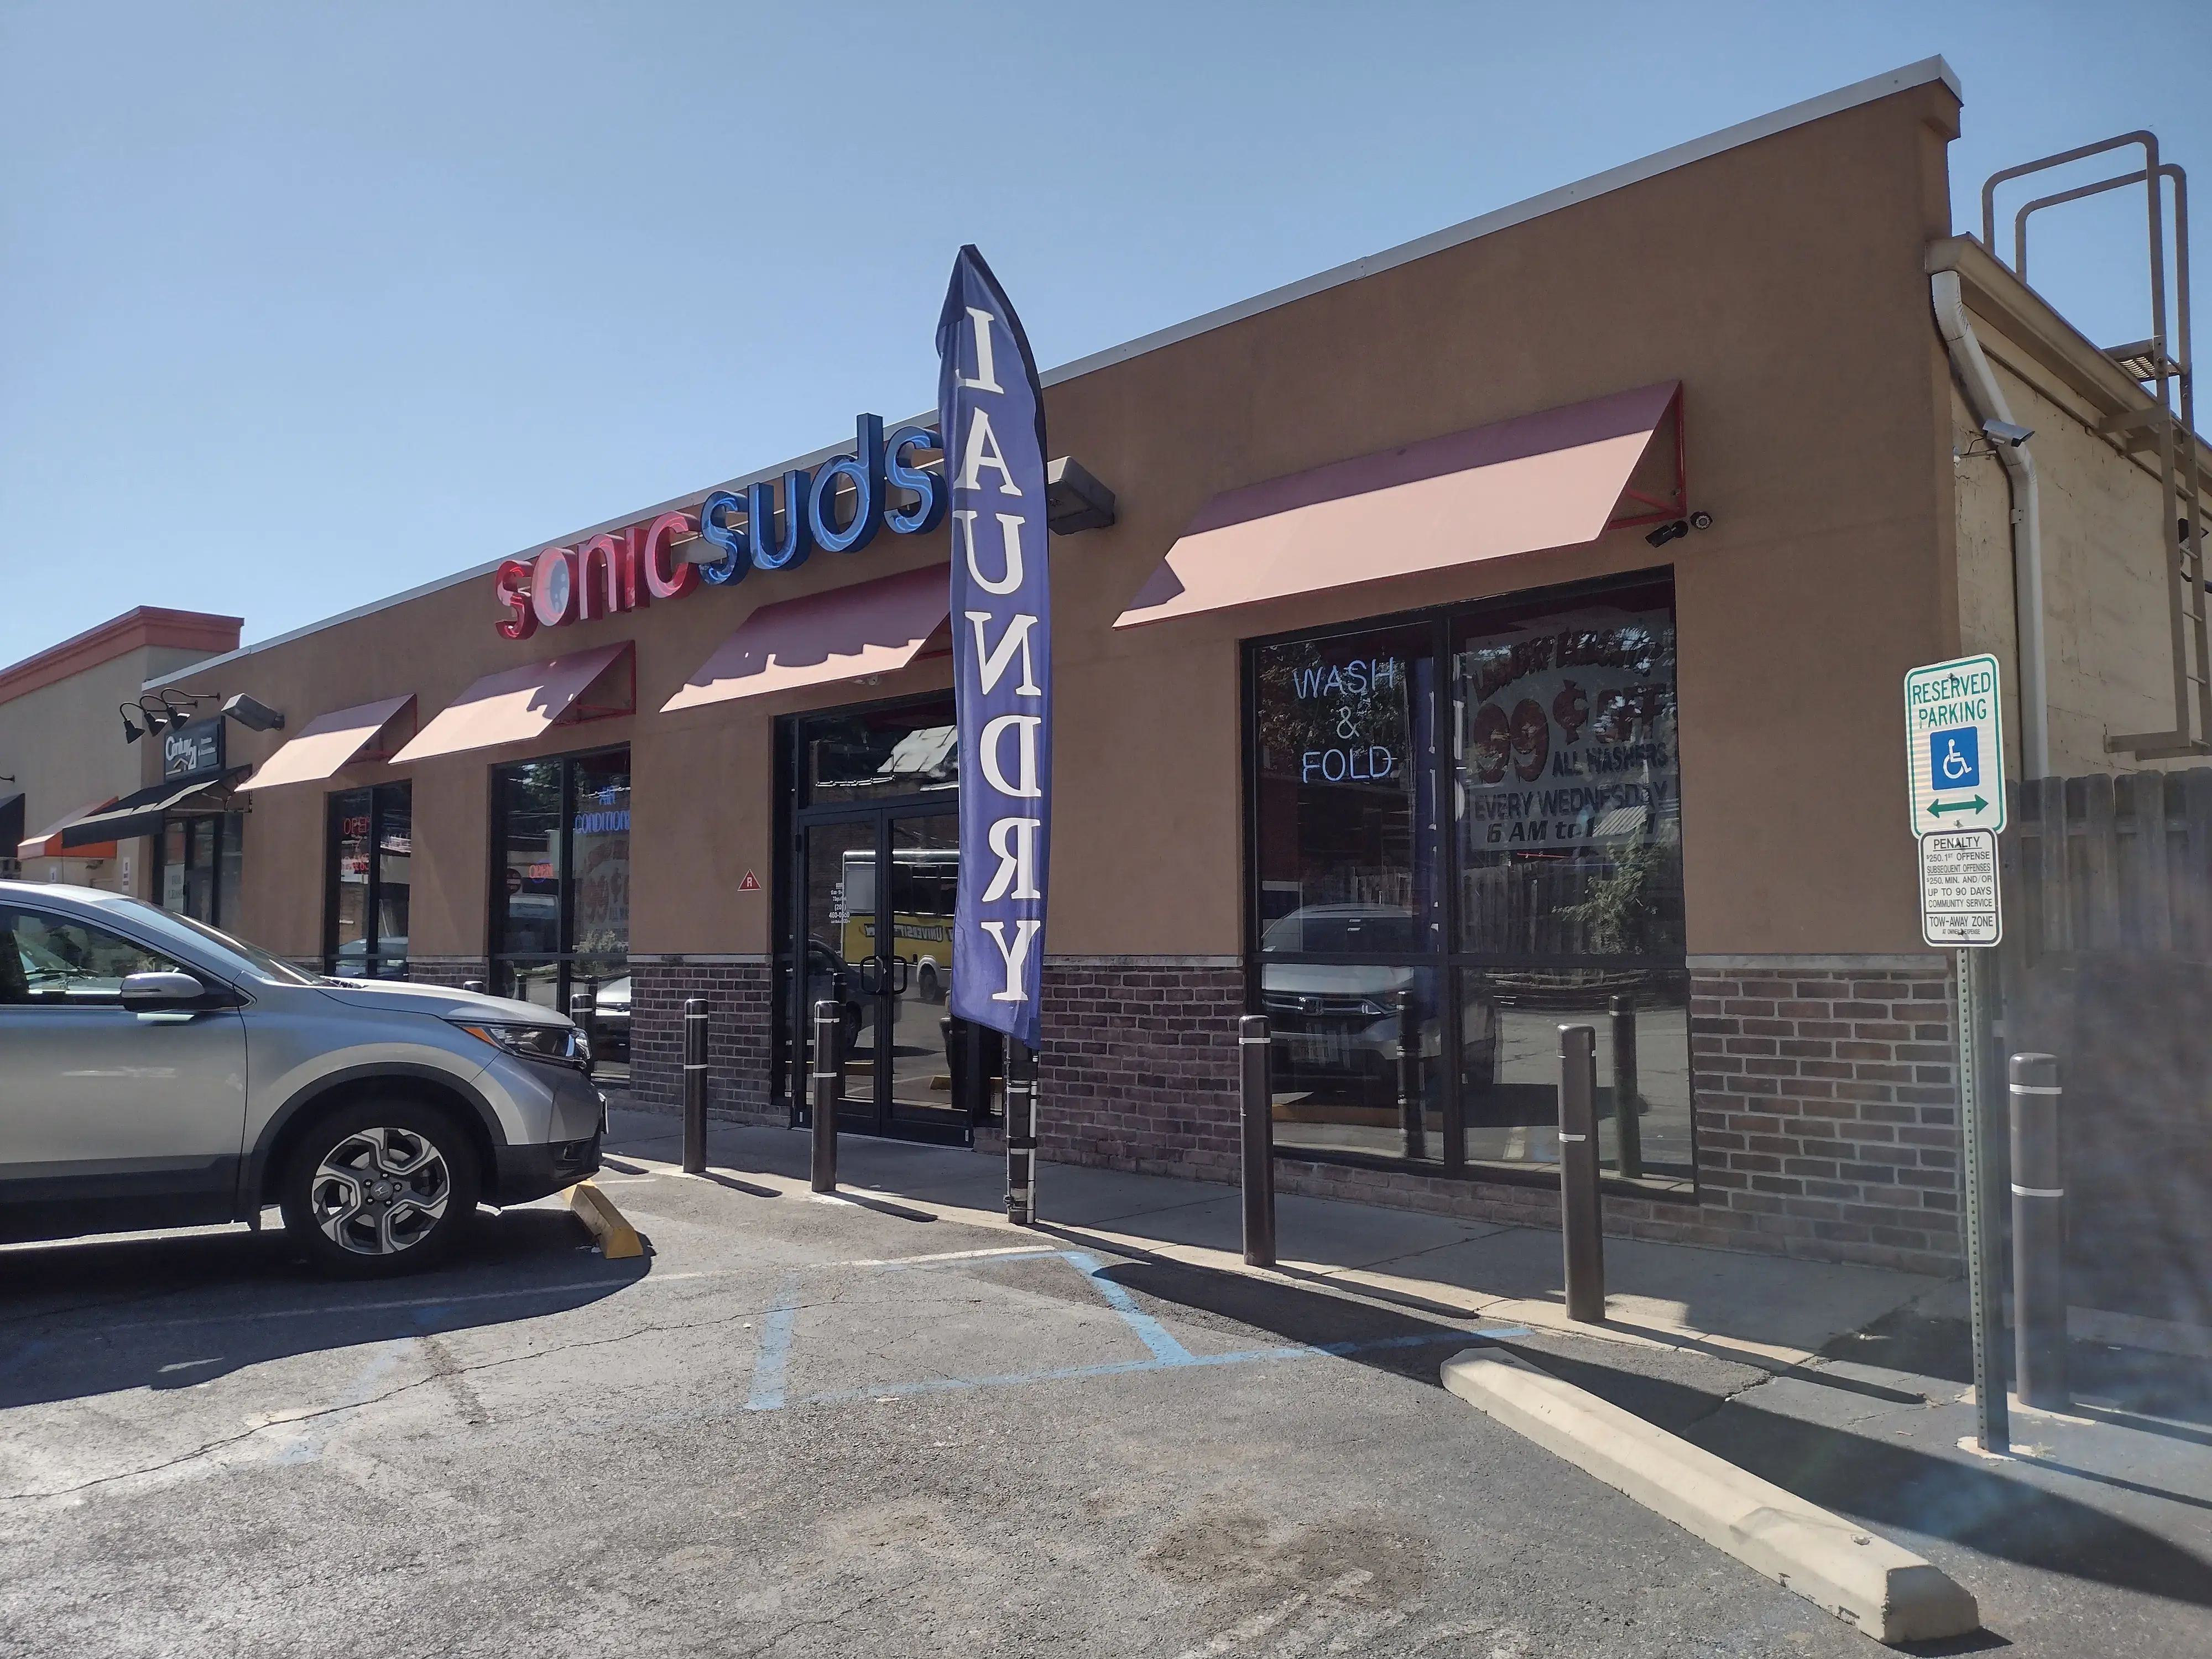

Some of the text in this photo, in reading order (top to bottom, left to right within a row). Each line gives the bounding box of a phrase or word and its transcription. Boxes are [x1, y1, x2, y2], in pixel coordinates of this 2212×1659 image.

[1292, 656, 1394, 700] WASH
[1912, 671, 1991, 705] RESERVED
[1919, 698, 1987, 729] PARKING
[1336, 705, 1361, 739] &
[1302, 745, 1392, 784] FOLD
[1474, 791, 1533, 821] EVERY
[1487, 822, 1503, 843] 6
[1509, 820, 1548, 842] AM
[1933, 836, 1980, 849] PENALTY
[1957, 852, 1990, 861] OFFENSE
[1927, 863, 1991, 874] SUBSEQUENT OFFENSES
[747, 877, 753, 887] R
[1962, 875, 1992, 884] AND/OR
[1928, 886, 1992, 896] UP TO 90 DAYS
[1928, 898, 1992, 908] COMMUNITY SERVICE
[1929, 916, 1994, 927] TOW-AWAY ZONE
